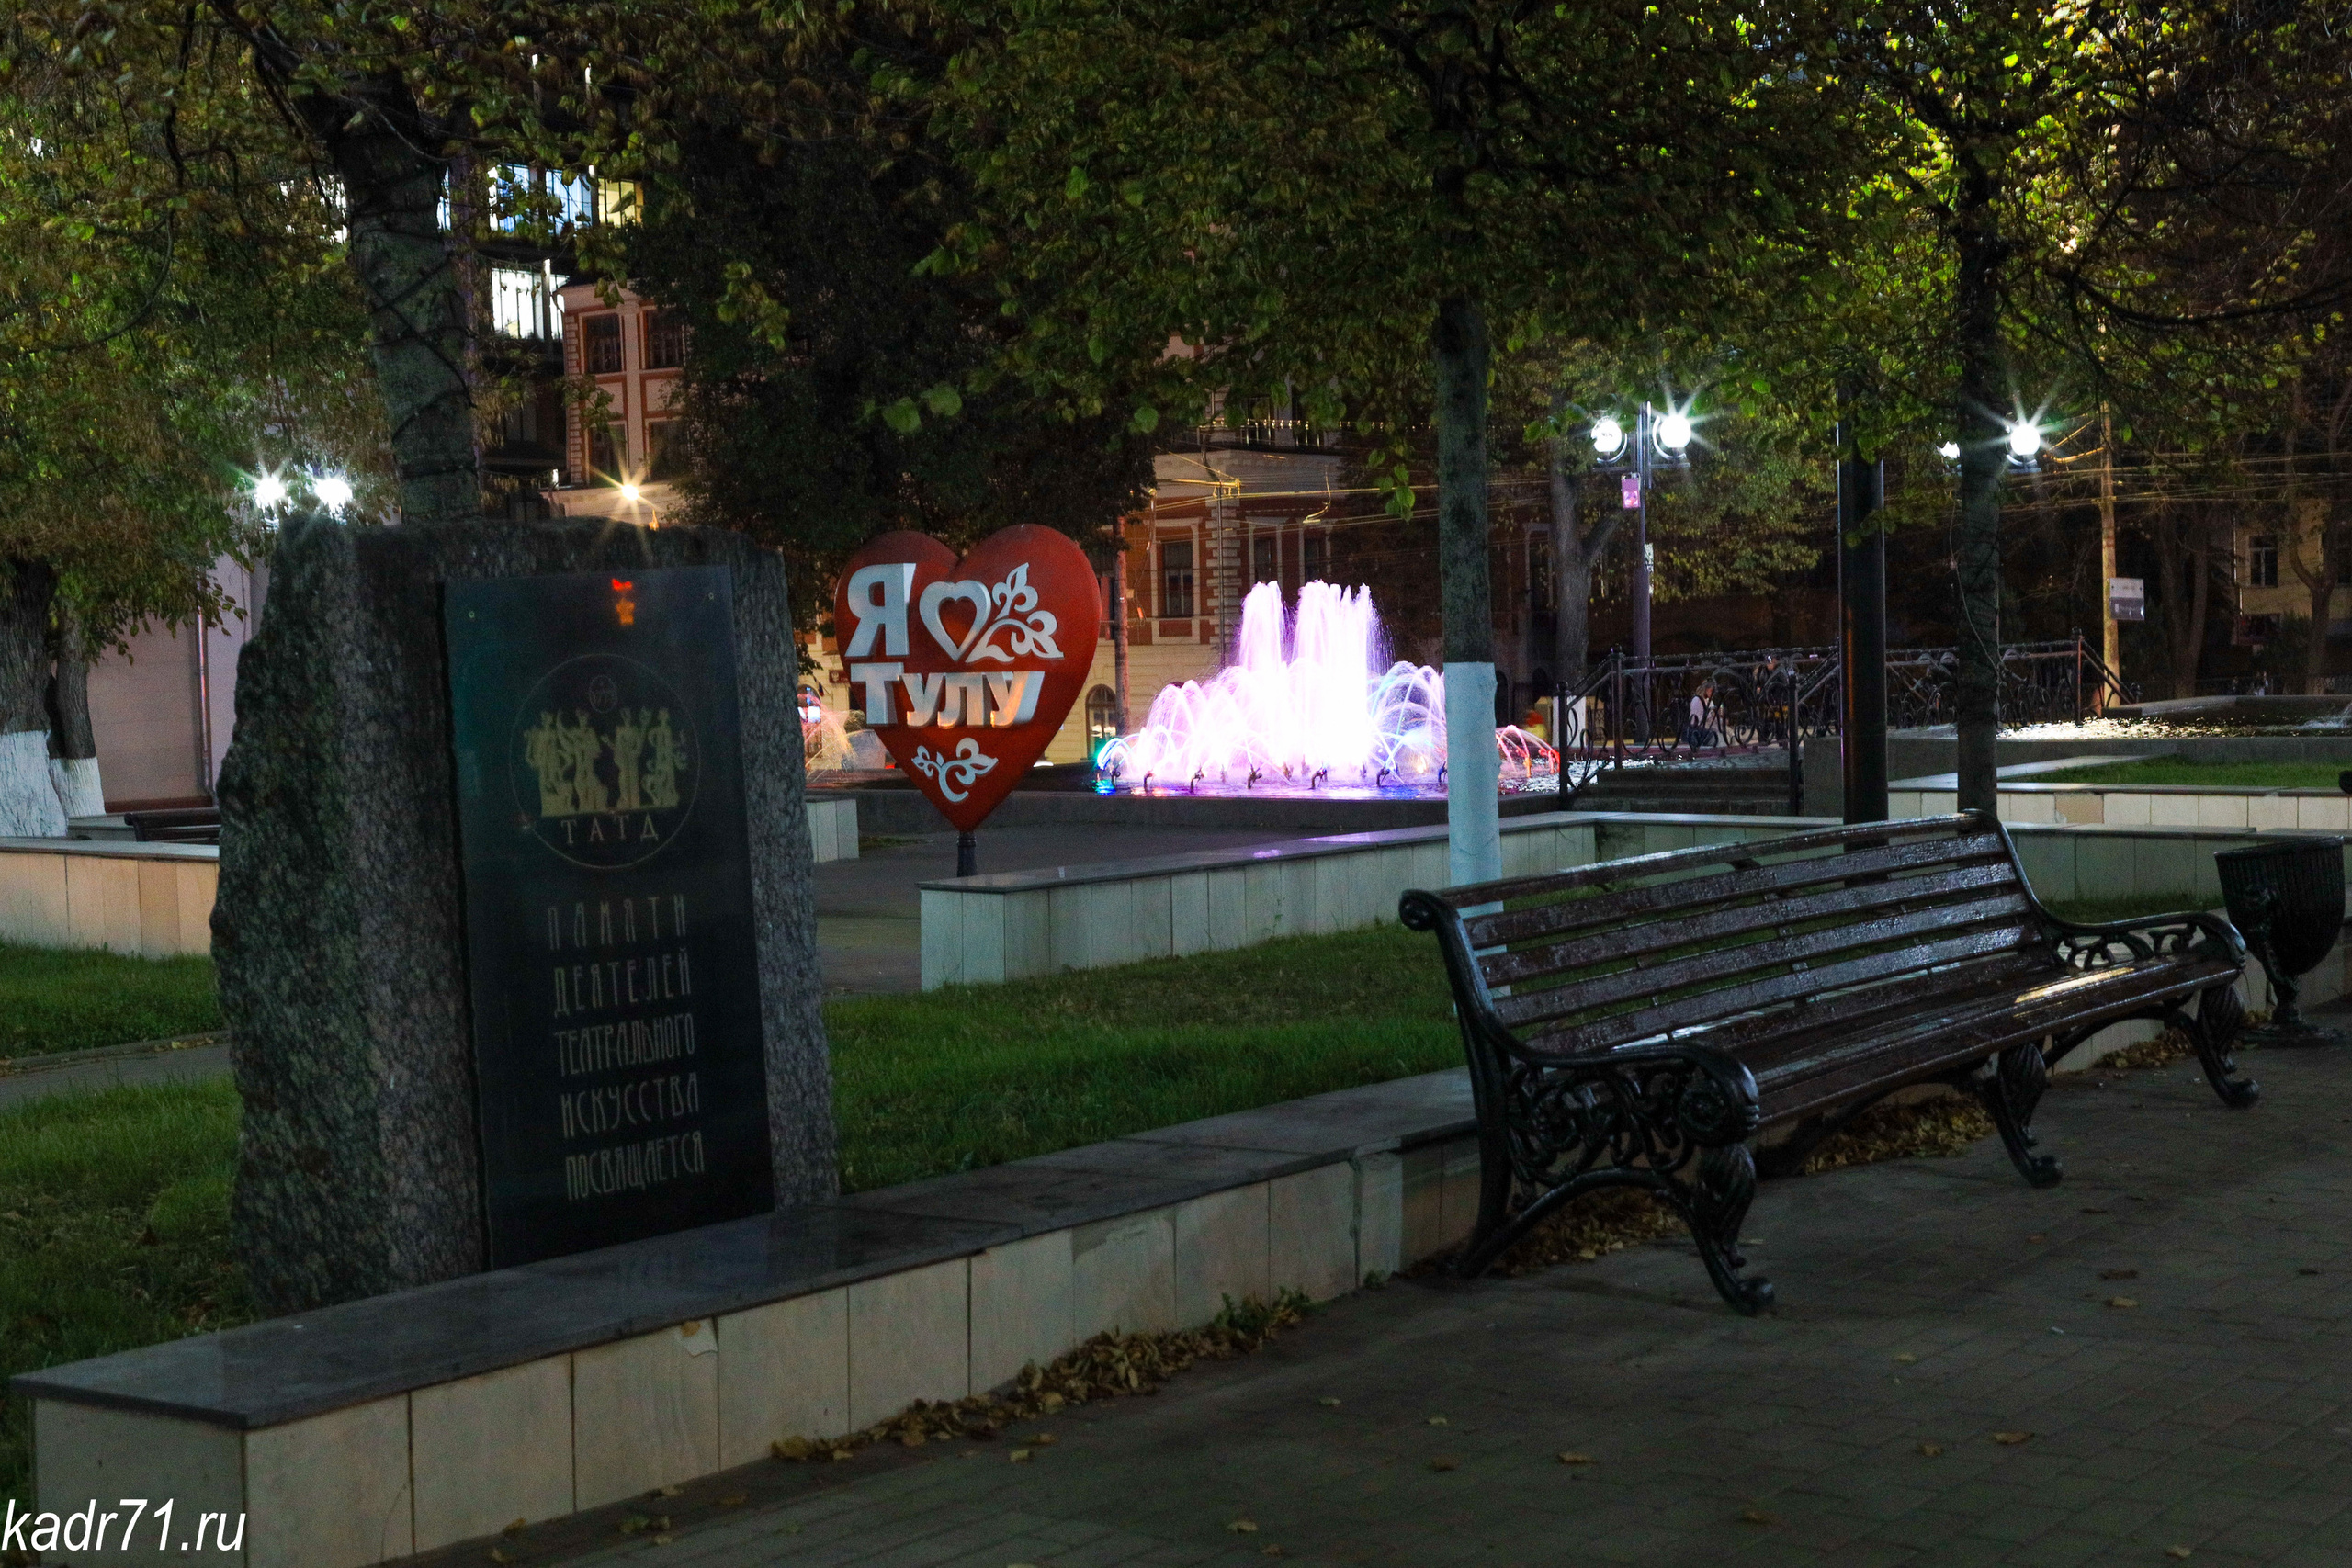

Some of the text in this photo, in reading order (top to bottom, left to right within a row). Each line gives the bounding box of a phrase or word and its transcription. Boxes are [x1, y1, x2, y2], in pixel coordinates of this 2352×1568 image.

[844, 562, 916, 658] Я
[548, 894, 686, 950] ПАМЯТИ
[554, 947, 691, 1018] ДЕЯТЕЛЕЙ
[555, 1013, 695, 1077] ТЕАТРАЛЬНОГО
[561, 1072, 699, 1139] ИСКУССТВА
[565, 1131, 705, 1201] ПОСВЯЩАЕТСЯ
